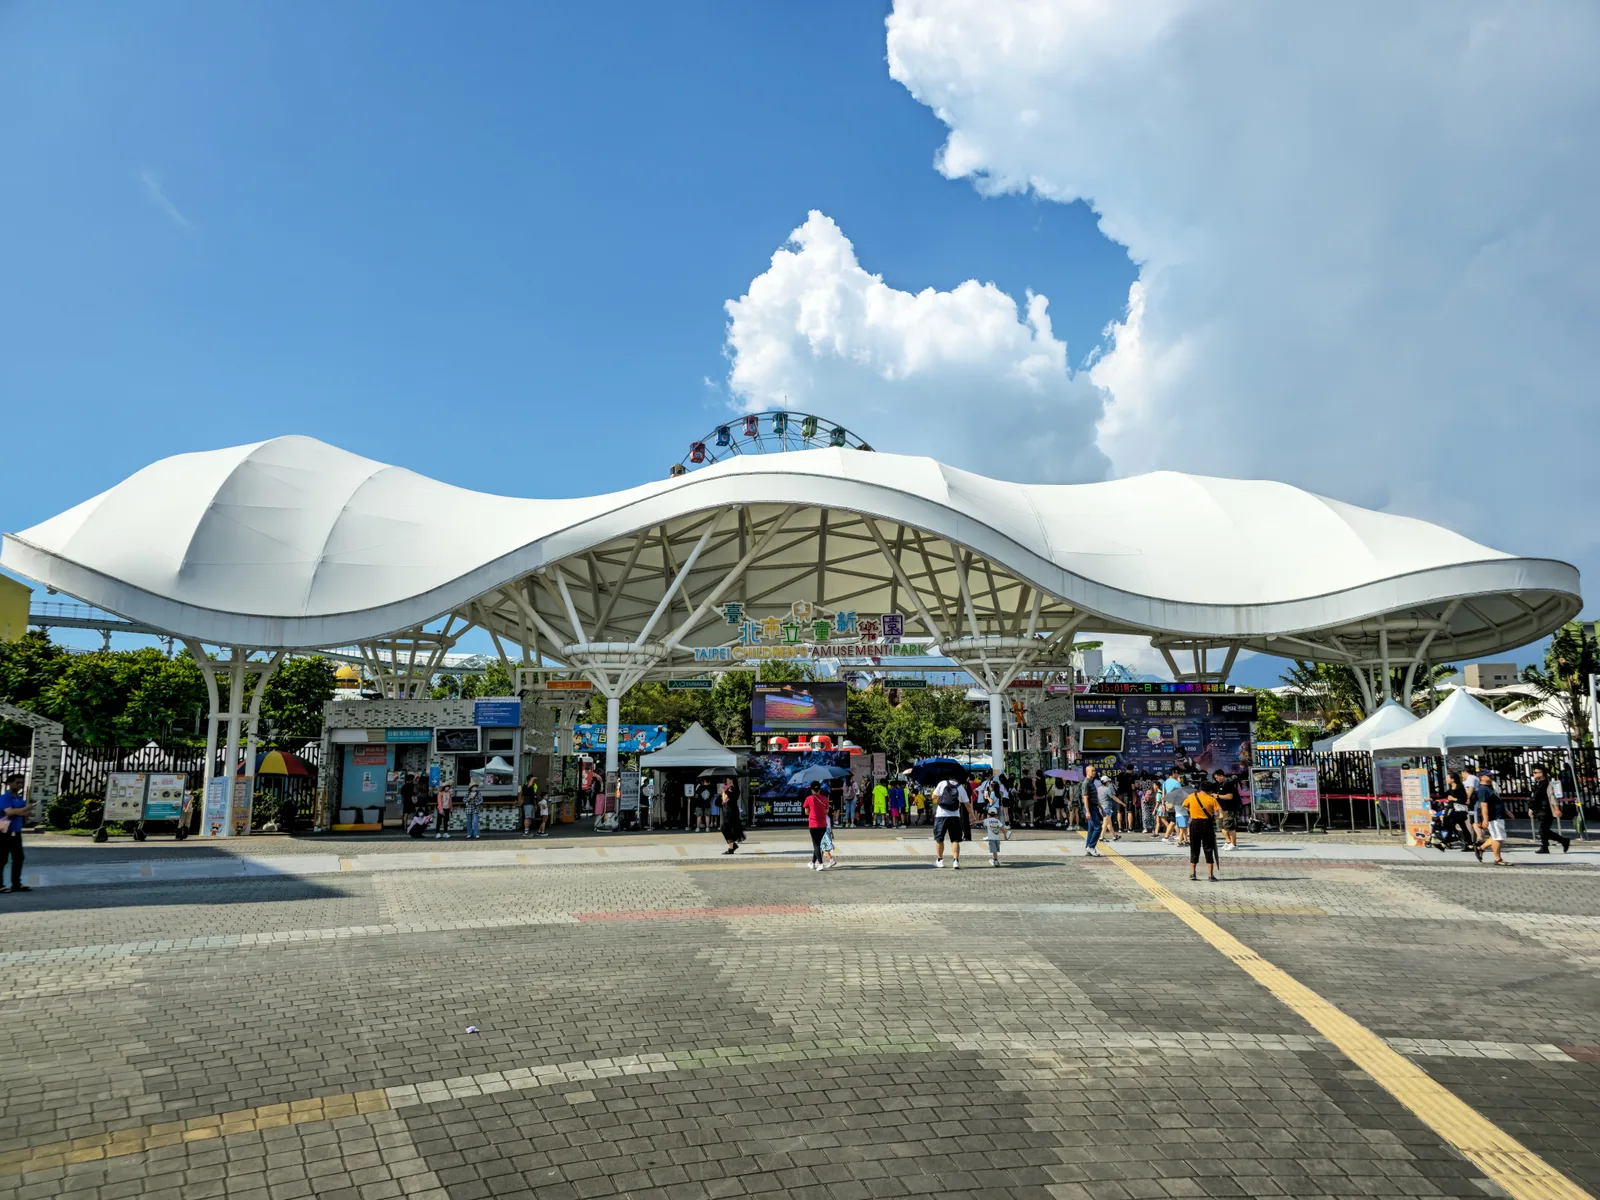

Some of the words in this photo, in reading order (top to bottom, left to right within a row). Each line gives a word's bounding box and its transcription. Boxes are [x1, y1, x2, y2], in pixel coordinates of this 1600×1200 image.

[694, 647, 731, 659] TAIPEI
[732, 646, 808, 659] CHILDREN'S
[812, 644, 889, 657] AMUSEMENT
[893, 643, 927, 657] PARK
[1147, 699, 1187, 712] 售票處
